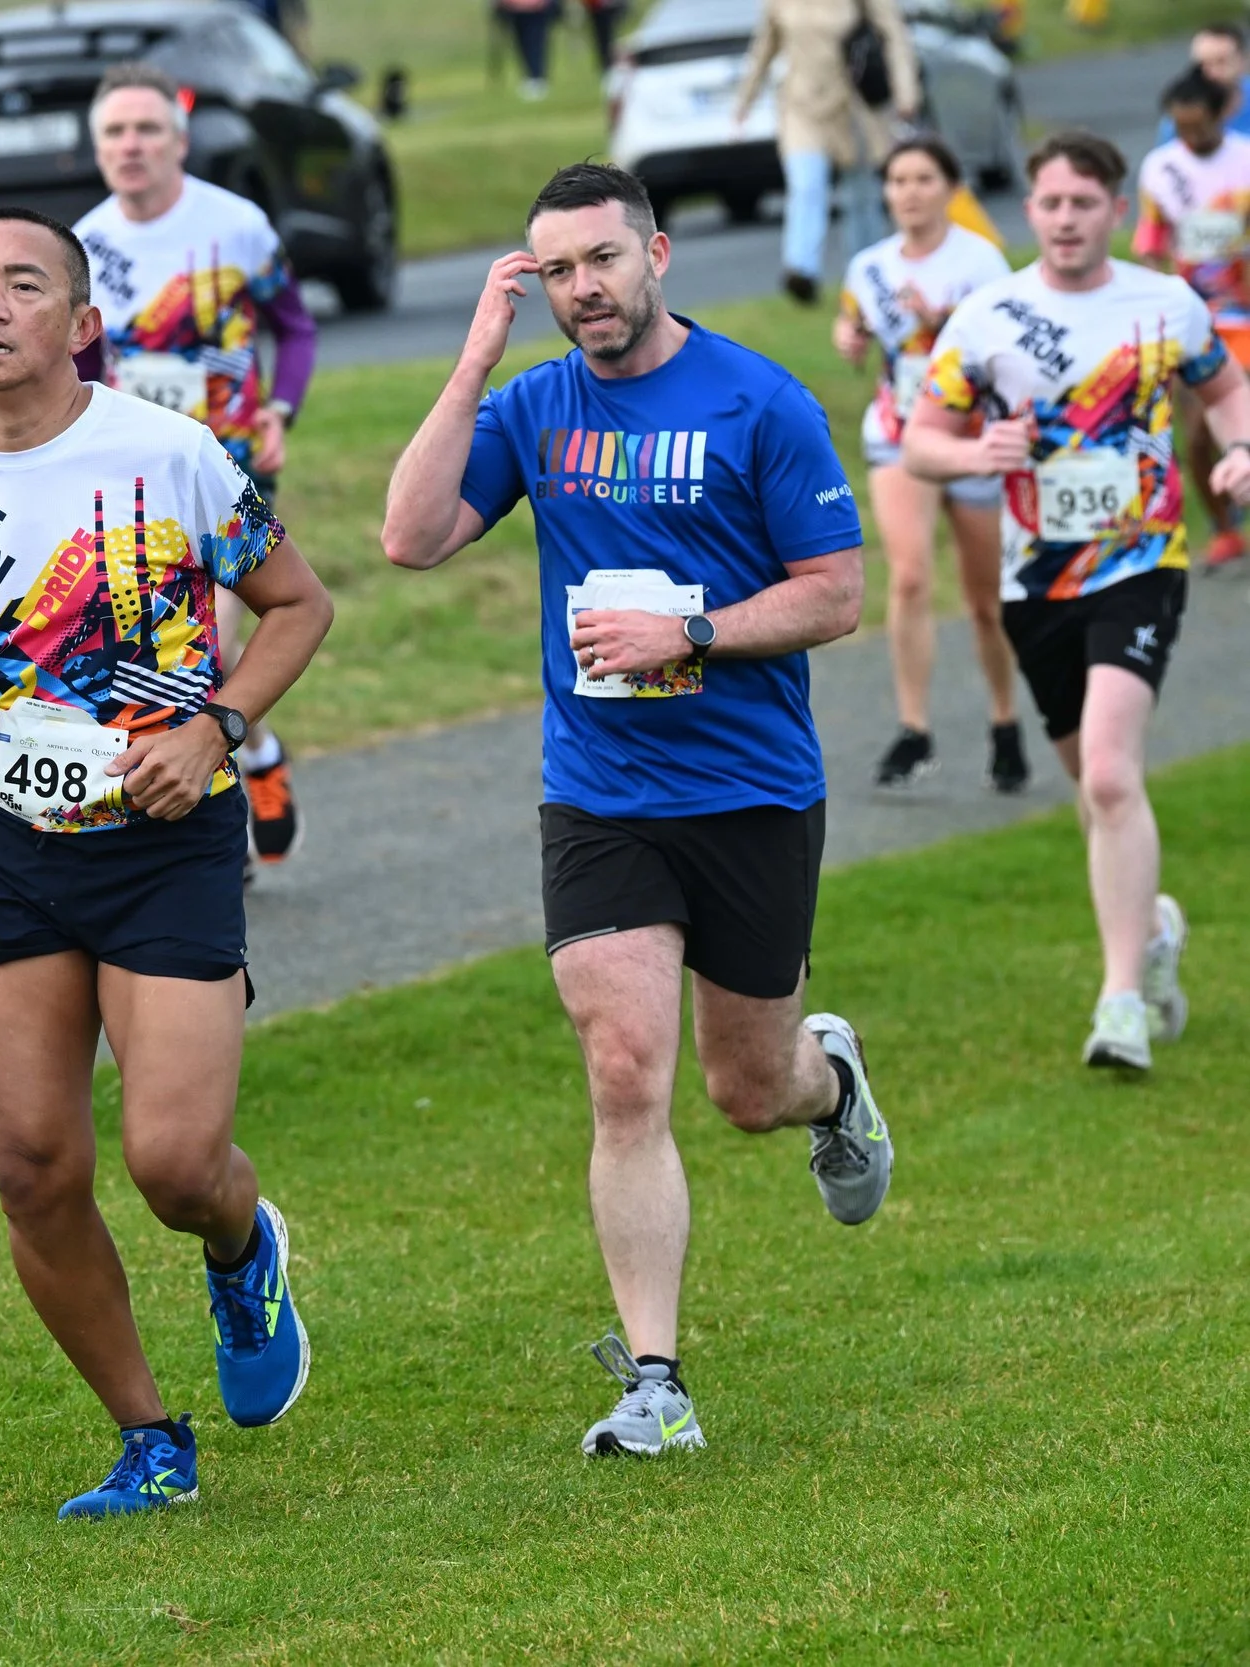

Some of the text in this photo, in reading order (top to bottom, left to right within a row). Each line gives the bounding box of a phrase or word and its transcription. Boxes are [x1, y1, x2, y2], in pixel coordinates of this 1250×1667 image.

[536, 479, 703, 504] BE YOURSELF
[815, 486, 840, 505] Well
[1056, 485, 1119, 519] 936
[33, 527, 96, 614] PRIDE
[19, 739, 39, 748] Origin
[46, 743, 70, 752] ARTHUR
[4, 753, 88, 804] 498
